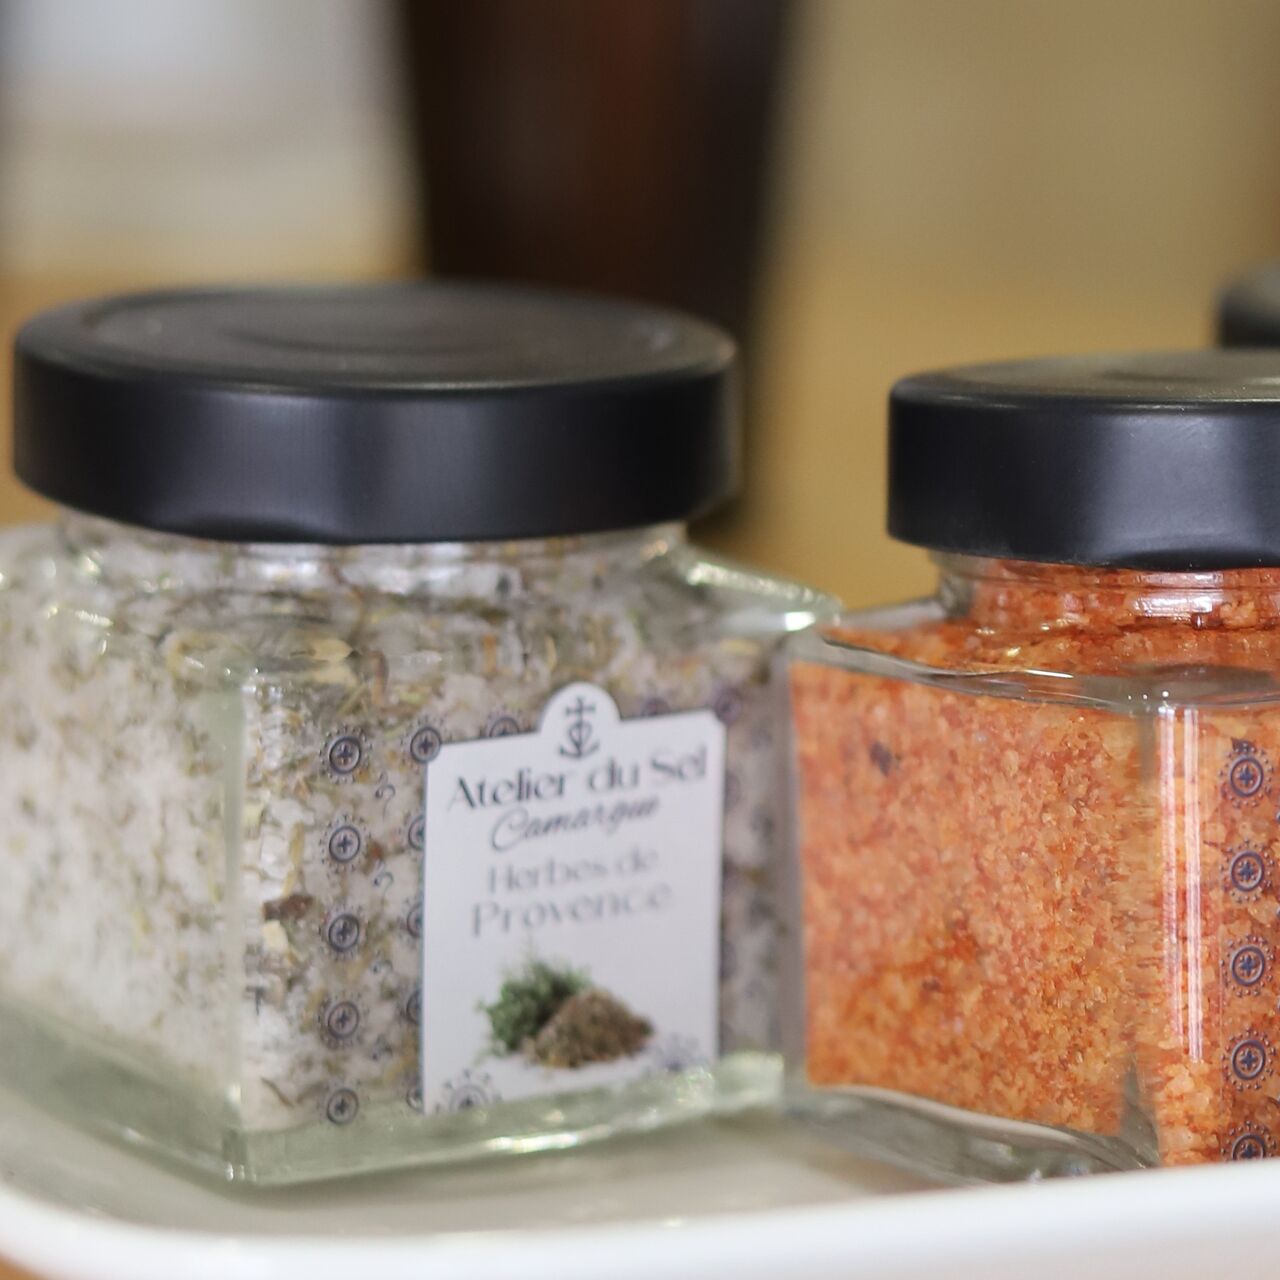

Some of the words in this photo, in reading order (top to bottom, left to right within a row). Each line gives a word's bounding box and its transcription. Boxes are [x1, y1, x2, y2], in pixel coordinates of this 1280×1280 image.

[447, 768, 576, 812] Atelier
[588, 756, 639, 791] du
[650, 746, 707, 782] Sel
[491, 795, 659, 850] Camargue
[488, 857, 607, 894] Herbes
[616, 846, 659, 877] de
[471, 882, 671, 938] Provence
